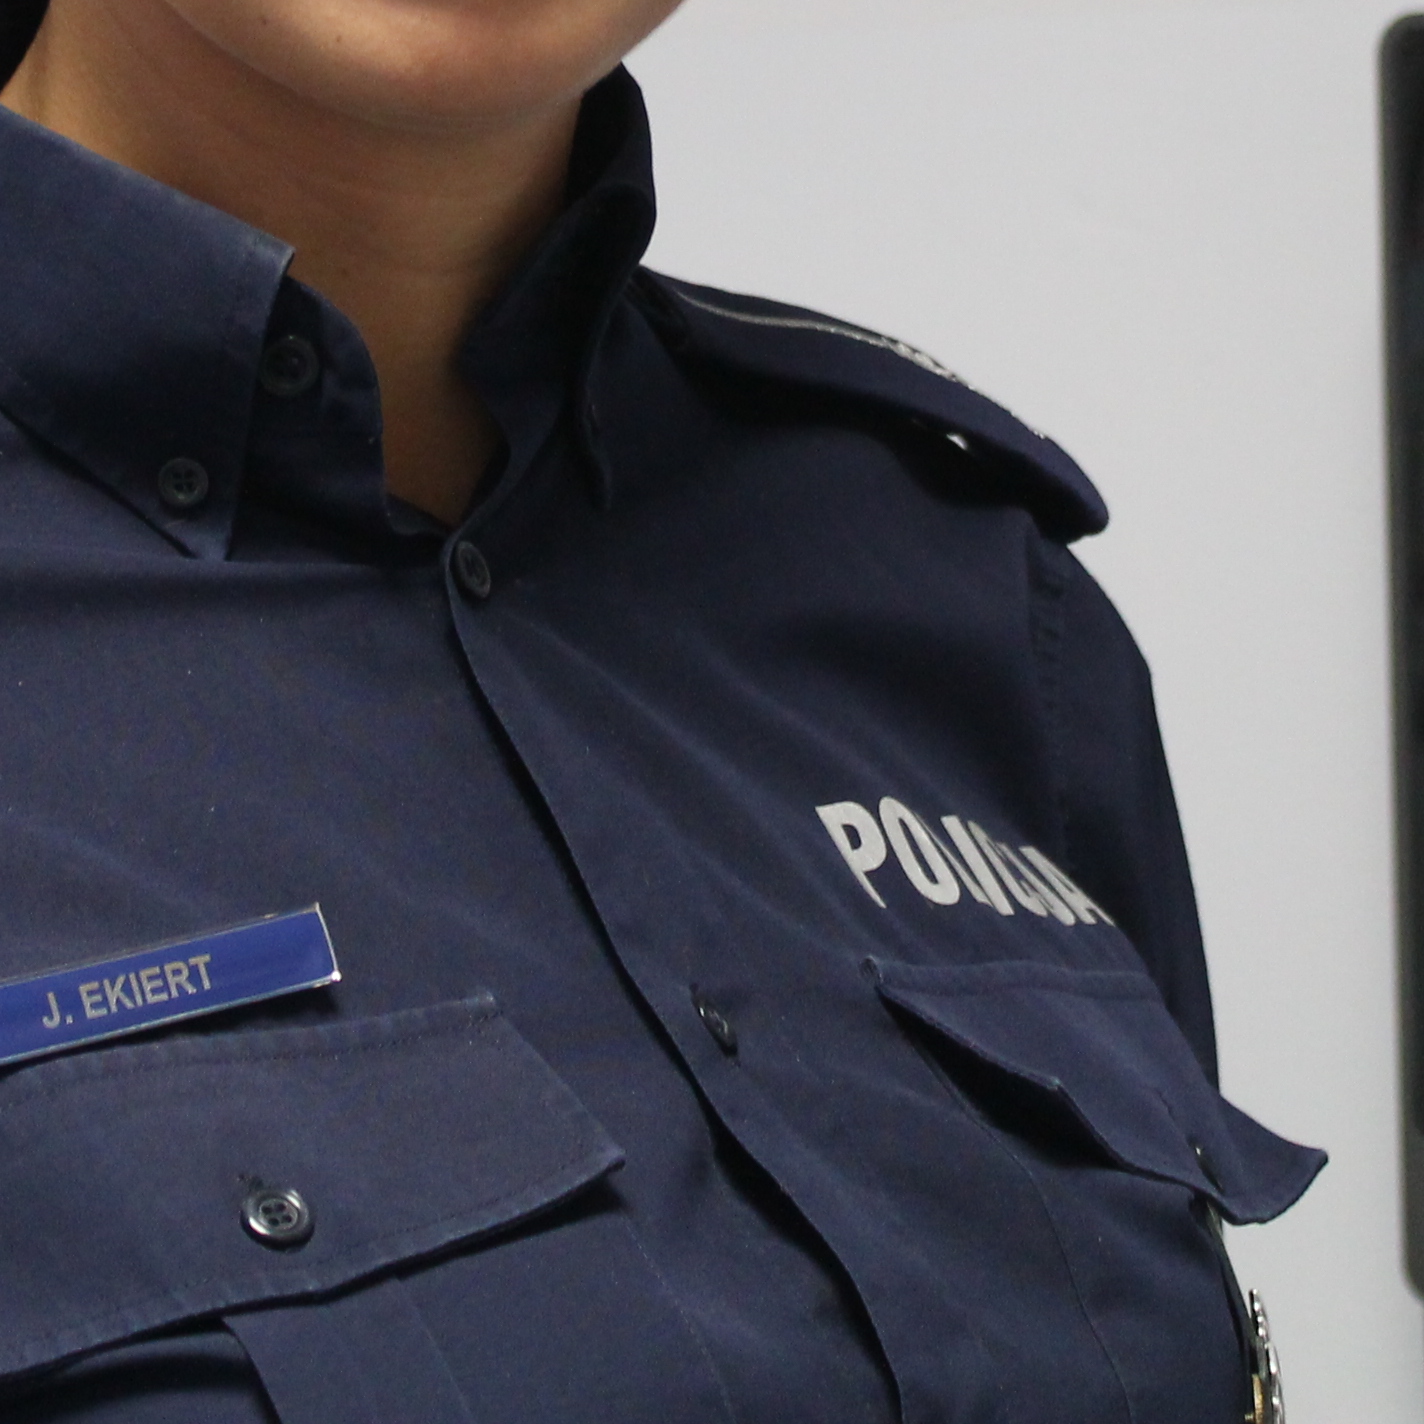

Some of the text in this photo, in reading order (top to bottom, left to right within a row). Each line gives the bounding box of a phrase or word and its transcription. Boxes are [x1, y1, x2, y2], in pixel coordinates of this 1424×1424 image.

[814, 795, 1117, 927] POLICJA
[42, 954, 212, 1029] J. EKIERT
